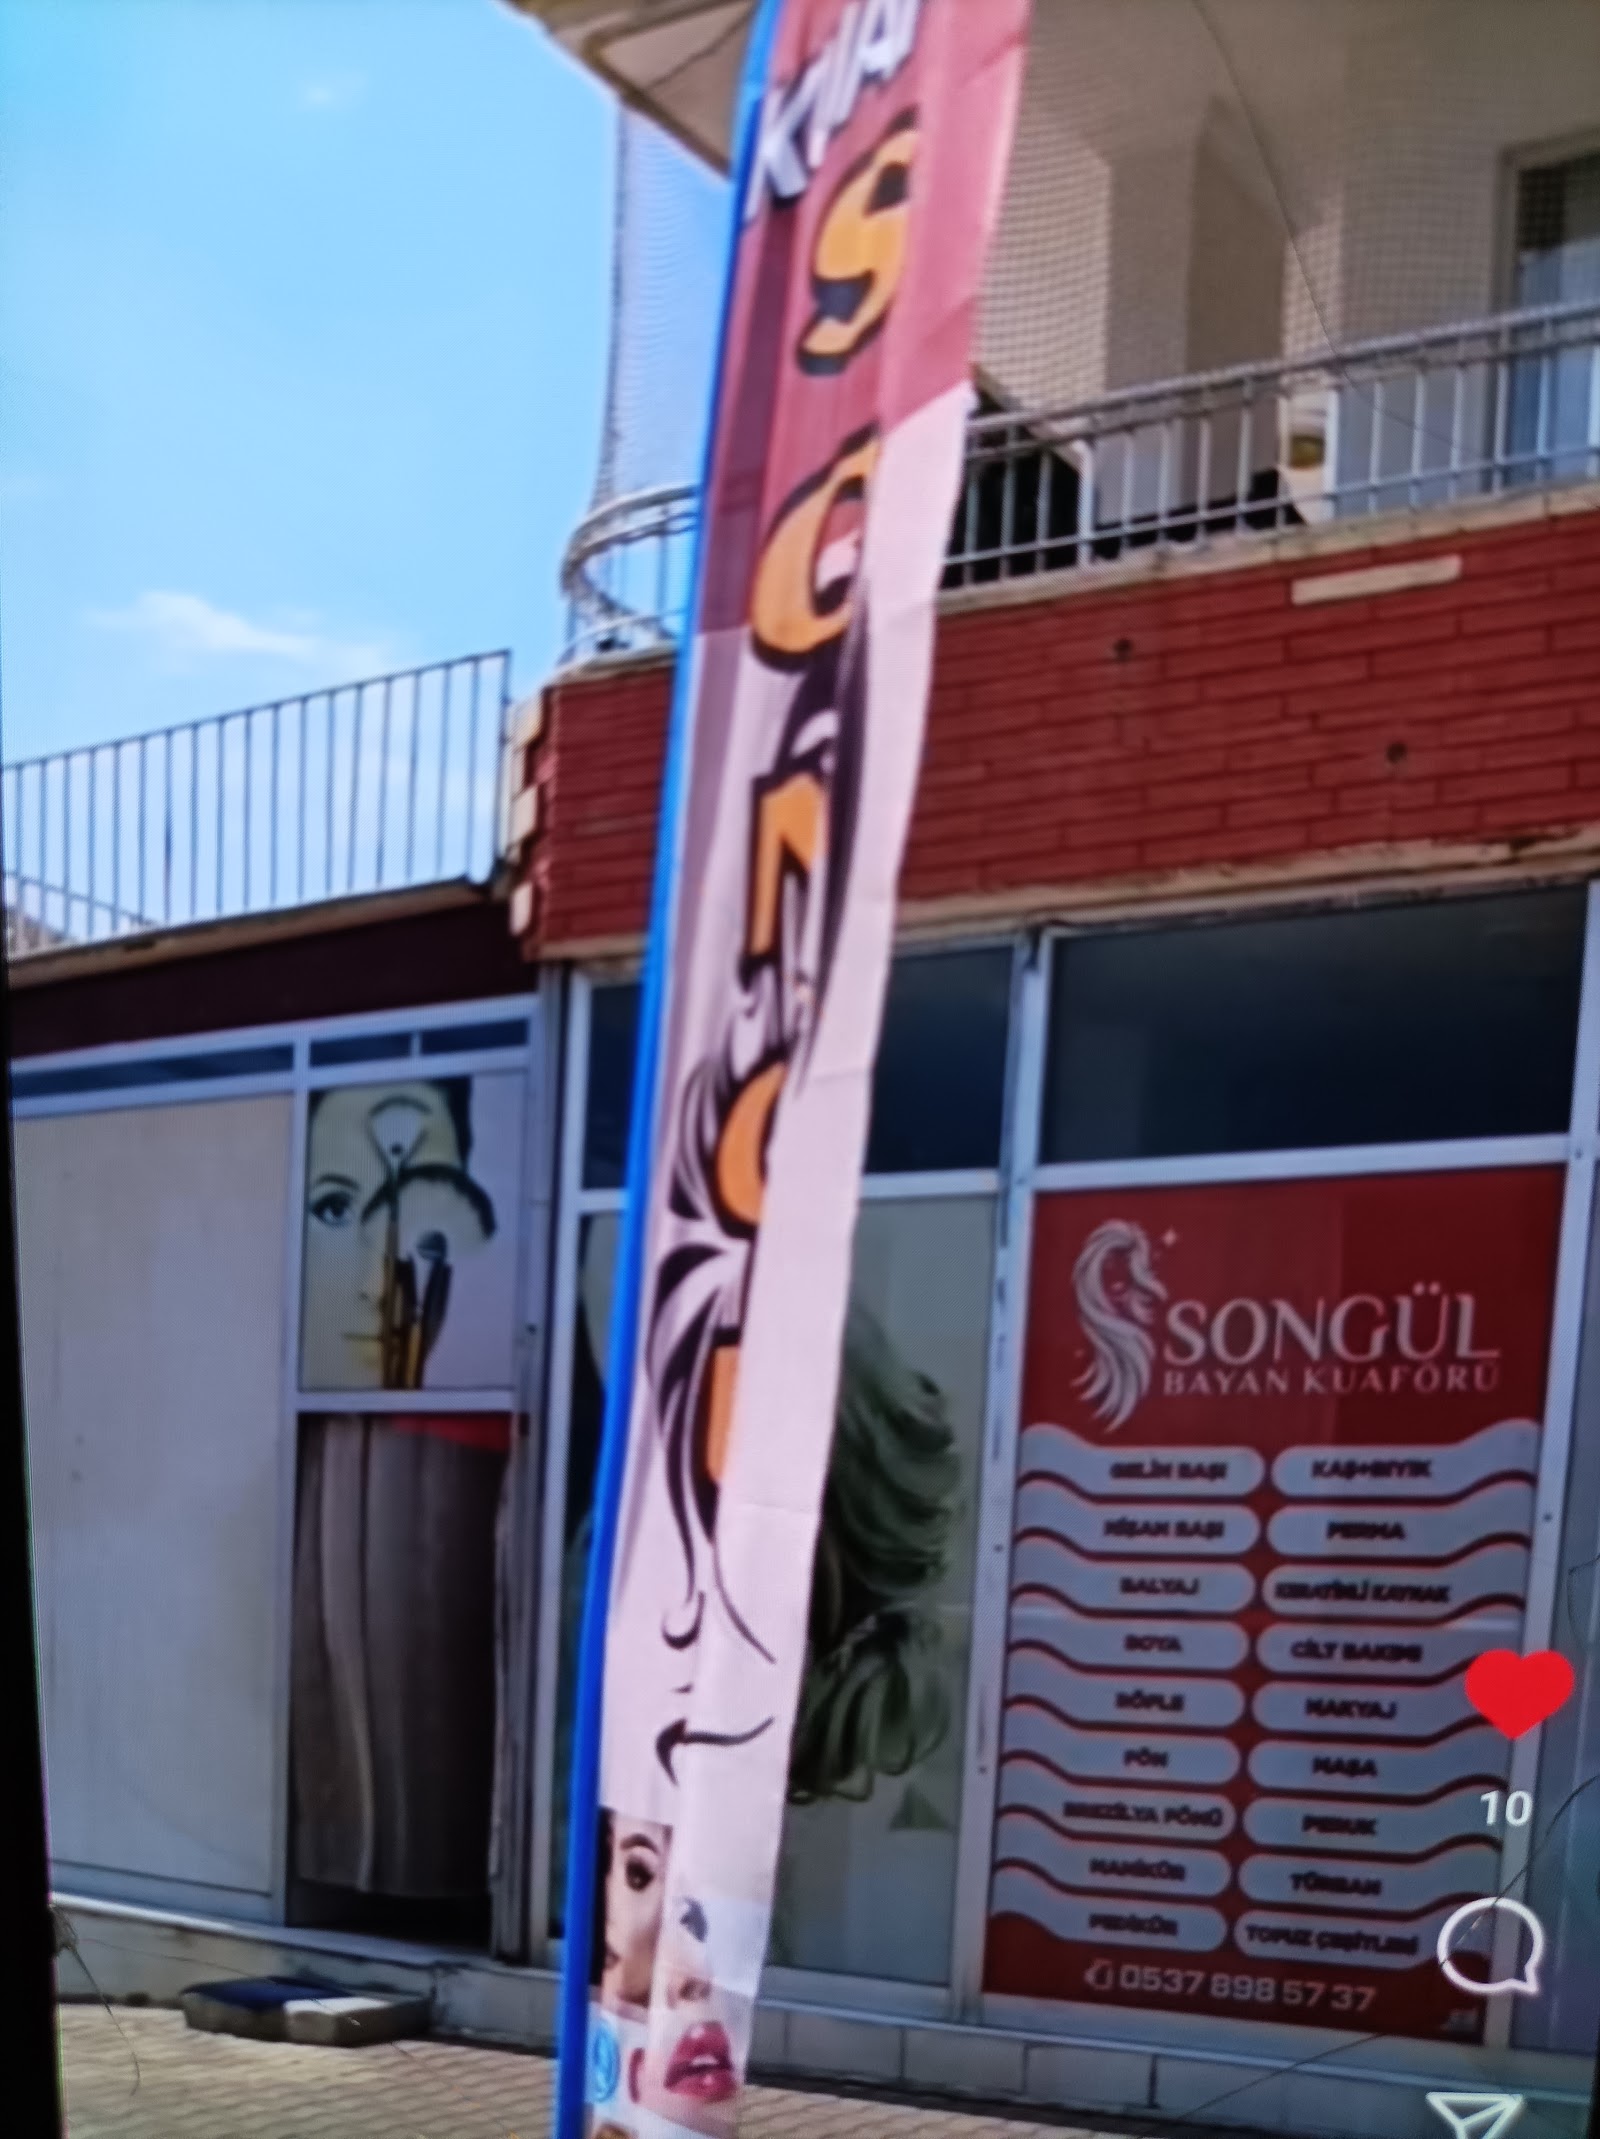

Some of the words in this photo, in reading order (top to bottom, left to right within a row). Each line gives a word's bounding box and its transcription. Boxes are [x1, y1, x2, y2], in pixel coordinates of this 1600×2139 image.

[1163, 1281, 1500, 1366] SONGÜL
[1164, 1367, 1288, 1396] BAYAN
[1303, 1361, 1499, 1393] KUAFÖRÜ
[1480, 1790, 1533, 1828] 10
[1118, 1964, 1205, 1995] 0537
[1282, 1978, 1324, 2007] 57
[1331, 1982, 1378, 2012] 37
